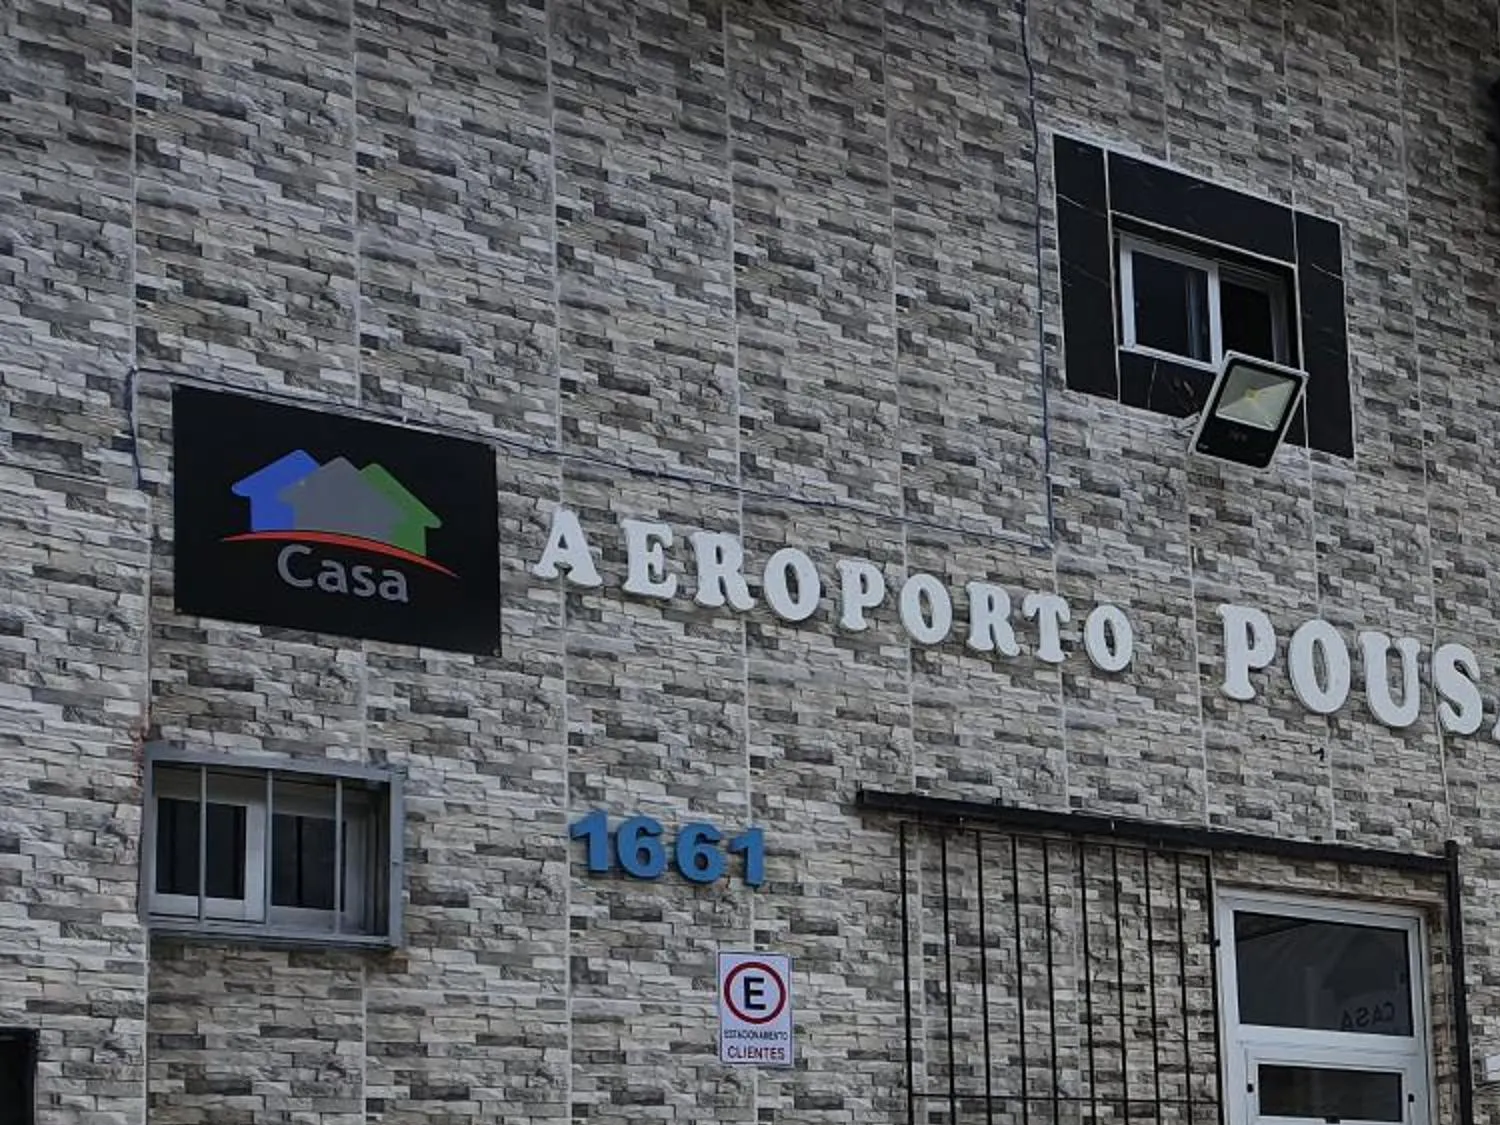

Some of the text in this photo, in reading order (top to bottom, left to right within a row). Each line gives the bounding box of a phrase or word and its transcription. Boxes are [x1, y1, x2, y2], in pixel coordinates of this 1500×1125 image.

[277, 544, 409, 603] Casa
[533, 508, 1135, 672] AEROPORTO
[569, 810, 766, 887] 1661
[743, 976, 767, 1011] E
[727, 1045, 785, 1060] CLIENTES
